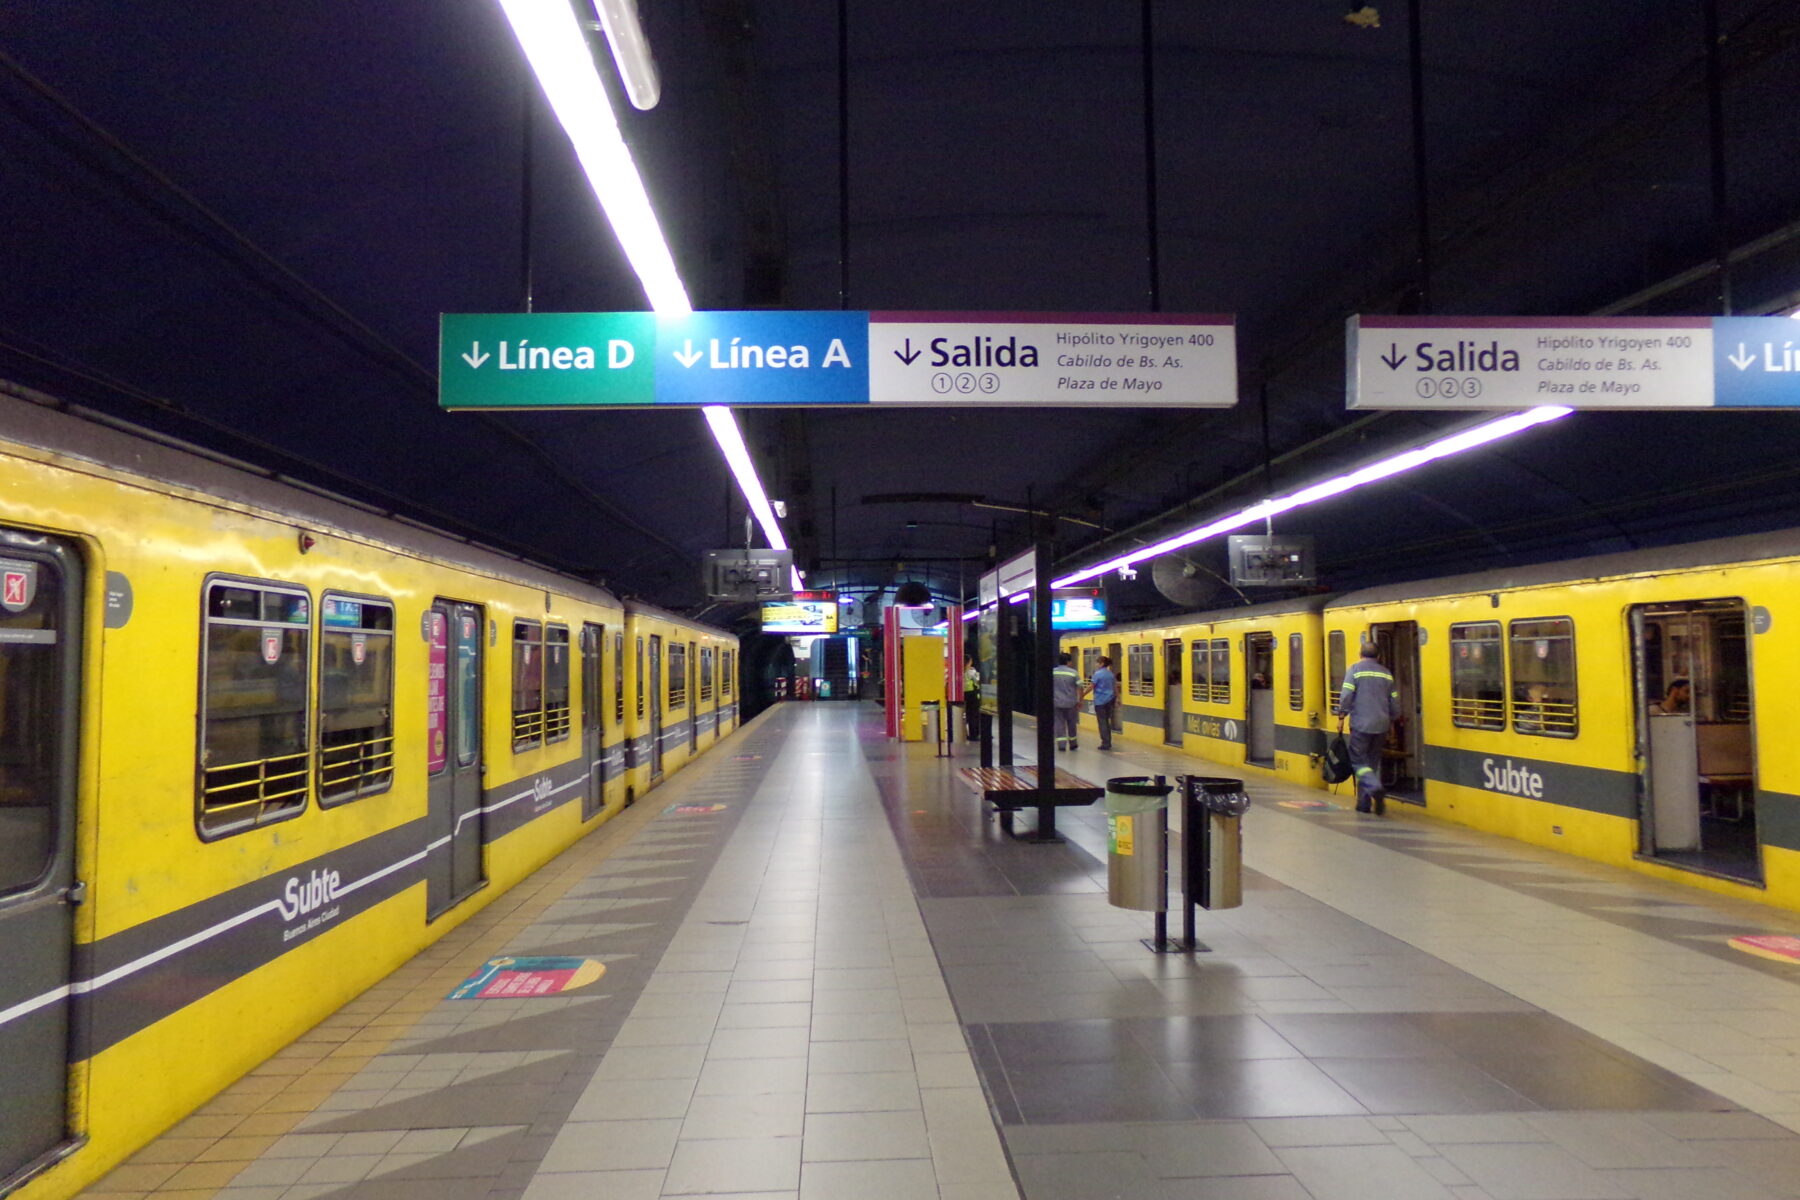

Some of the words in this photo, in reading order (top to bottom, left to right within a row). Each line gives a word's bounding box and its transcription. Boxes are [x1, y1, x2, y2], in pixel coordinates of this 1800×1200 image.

[499, 339, 595, 369] Línea
[608, 339, 635, 369] D
[710, 337, 809, 369] Línea
[822, 338, 852, 368] A
[930, 336, 1039, 367] Salida
[1056, 333, 1115, 347] Hipólito
[1119, 333, 1184, 349] Yrigoyen
[1188, 334, 1214, 346] 400
[1537, 337, 1594, 351] Hipólito
[1598, 337, 1662, 351] Yrigoyen
[1666, 336, 1692, 349] 400
[1057, 354, 1112, 367] Cabildo
[1116, 355, 1134, 367] de
[1139, 356, 1158, 368] Bs.
[1162, 356, 1183, 368] As.
[1416, 341, 1520, 372] Salida
[1538, 358, 1591, 371] Cabildo
[1595, 359, 1612, 371] de
[1617, 359, 1636, 371] Bs.
[1641, 359, 1662, 371] As.
[1764, 341, 1800, 372] Lí
[1057, 377, 1095, 390] Plaza
[1100, 377, 1118, 390] de
[1122, 378, 1162, 393] Mayo
[1538, 381, 1574, 393] Plaza
[1579, 381, 1596, 393] de
[1600, 381, 1641, 396] Mayo
[1483, 758, 1543, 798] Subte
[281, 868, 340, 921] Subte
